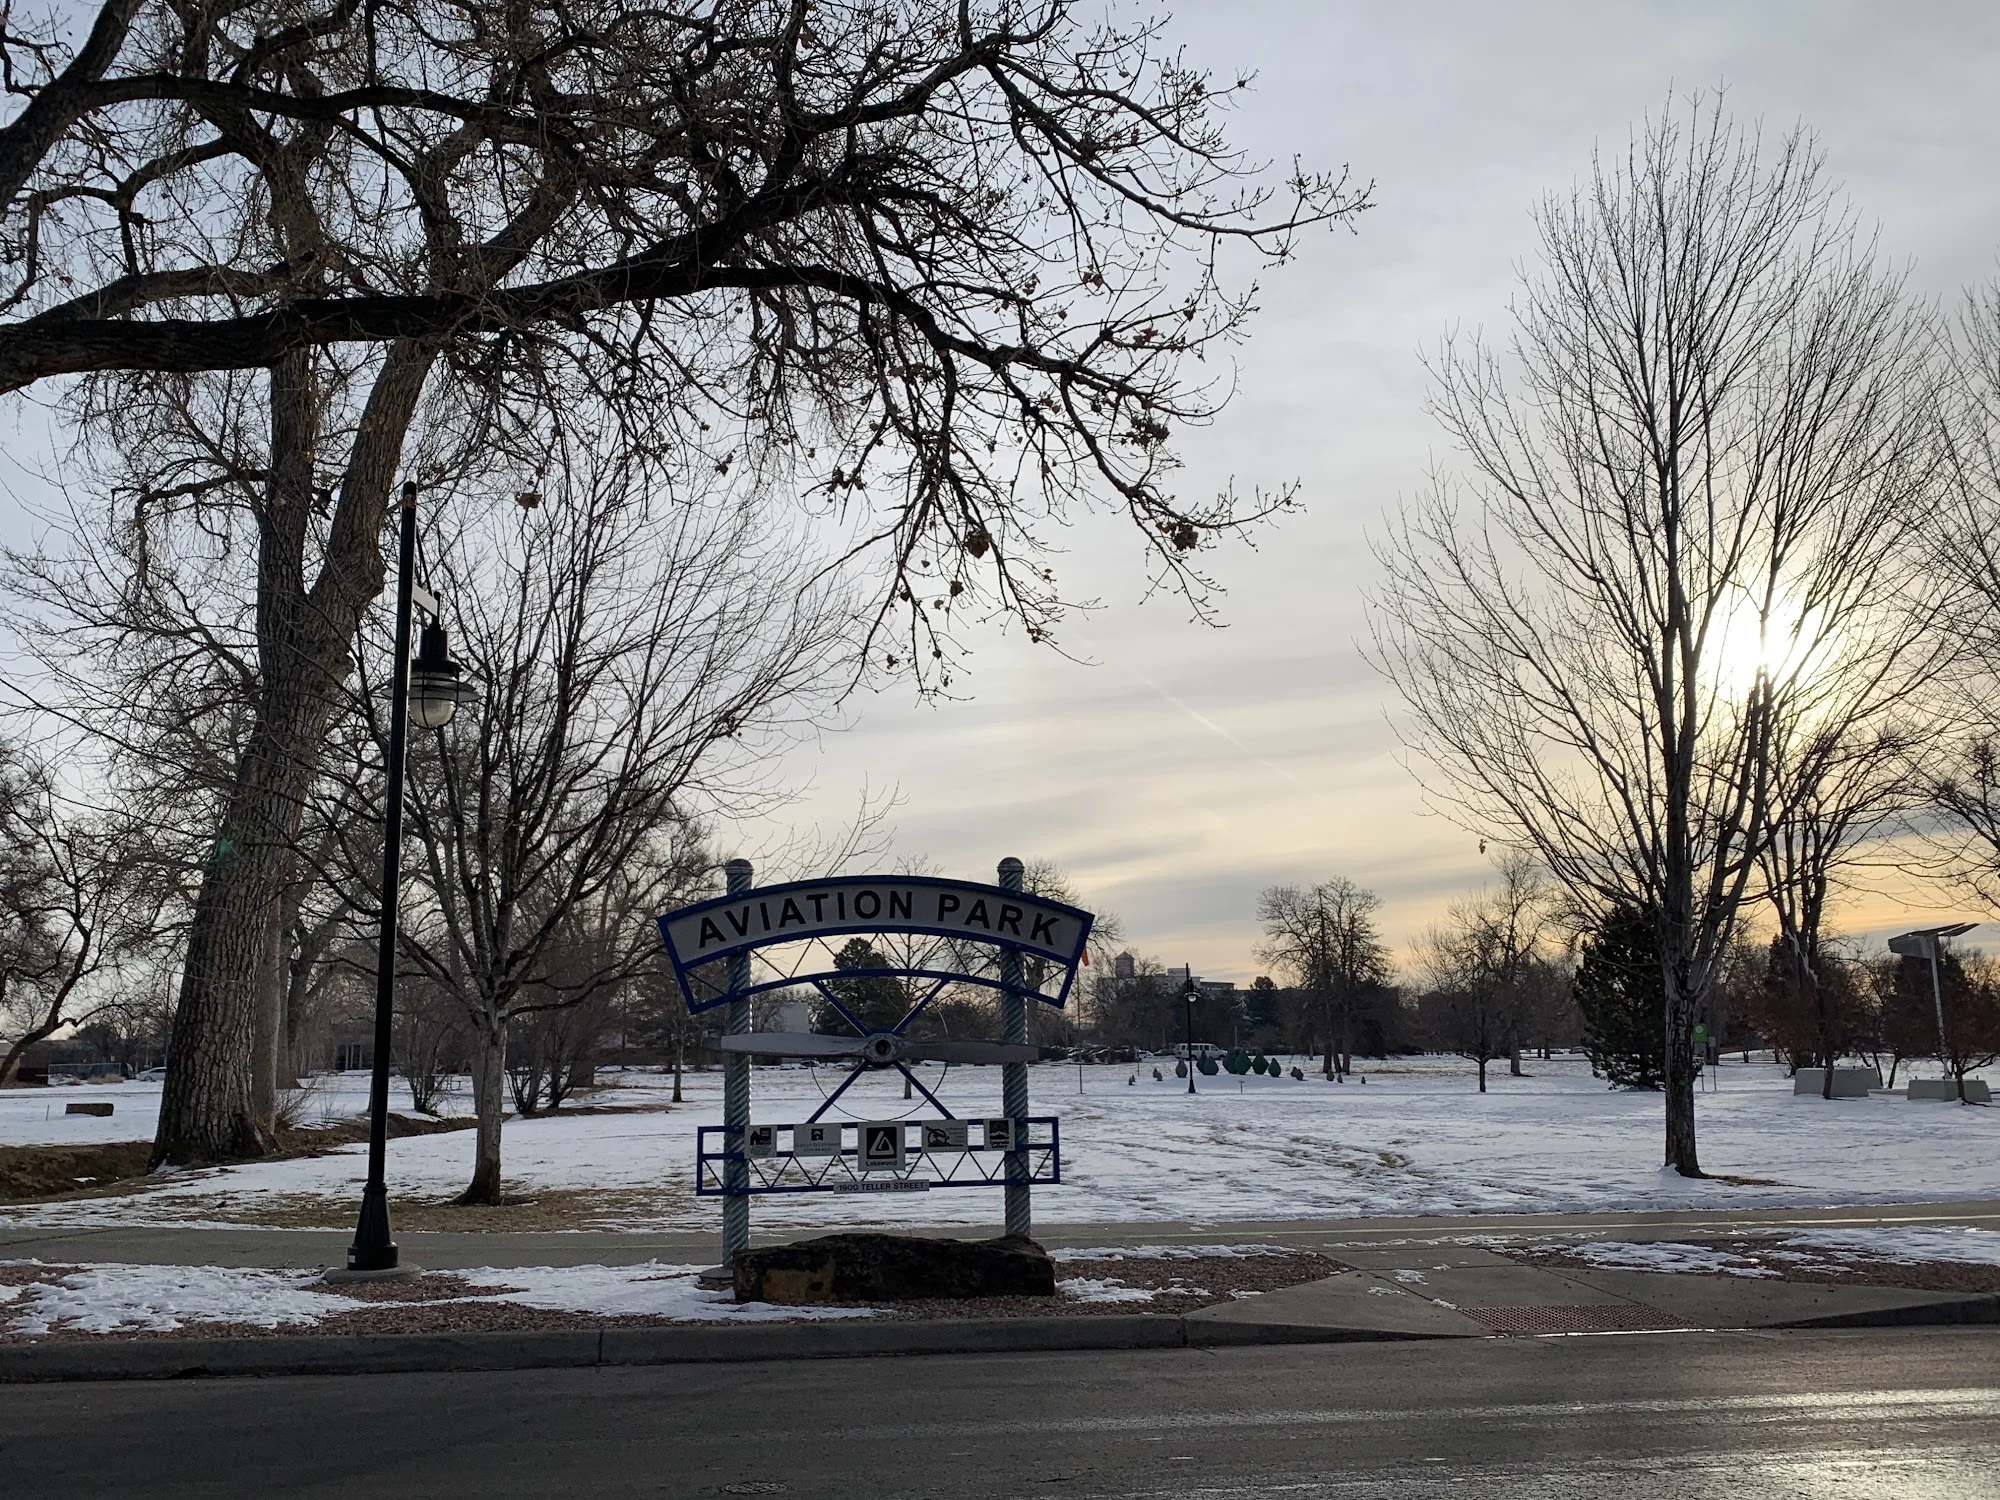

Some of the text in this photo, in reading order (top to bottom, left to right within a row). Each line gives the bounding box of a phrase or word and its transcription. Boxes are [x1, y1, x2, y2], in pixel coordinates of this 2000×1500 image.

[697, 889, 1061, 949] AVIATION PARK
[838, 1181, 925, 1192] 1900 TELLER STREET
